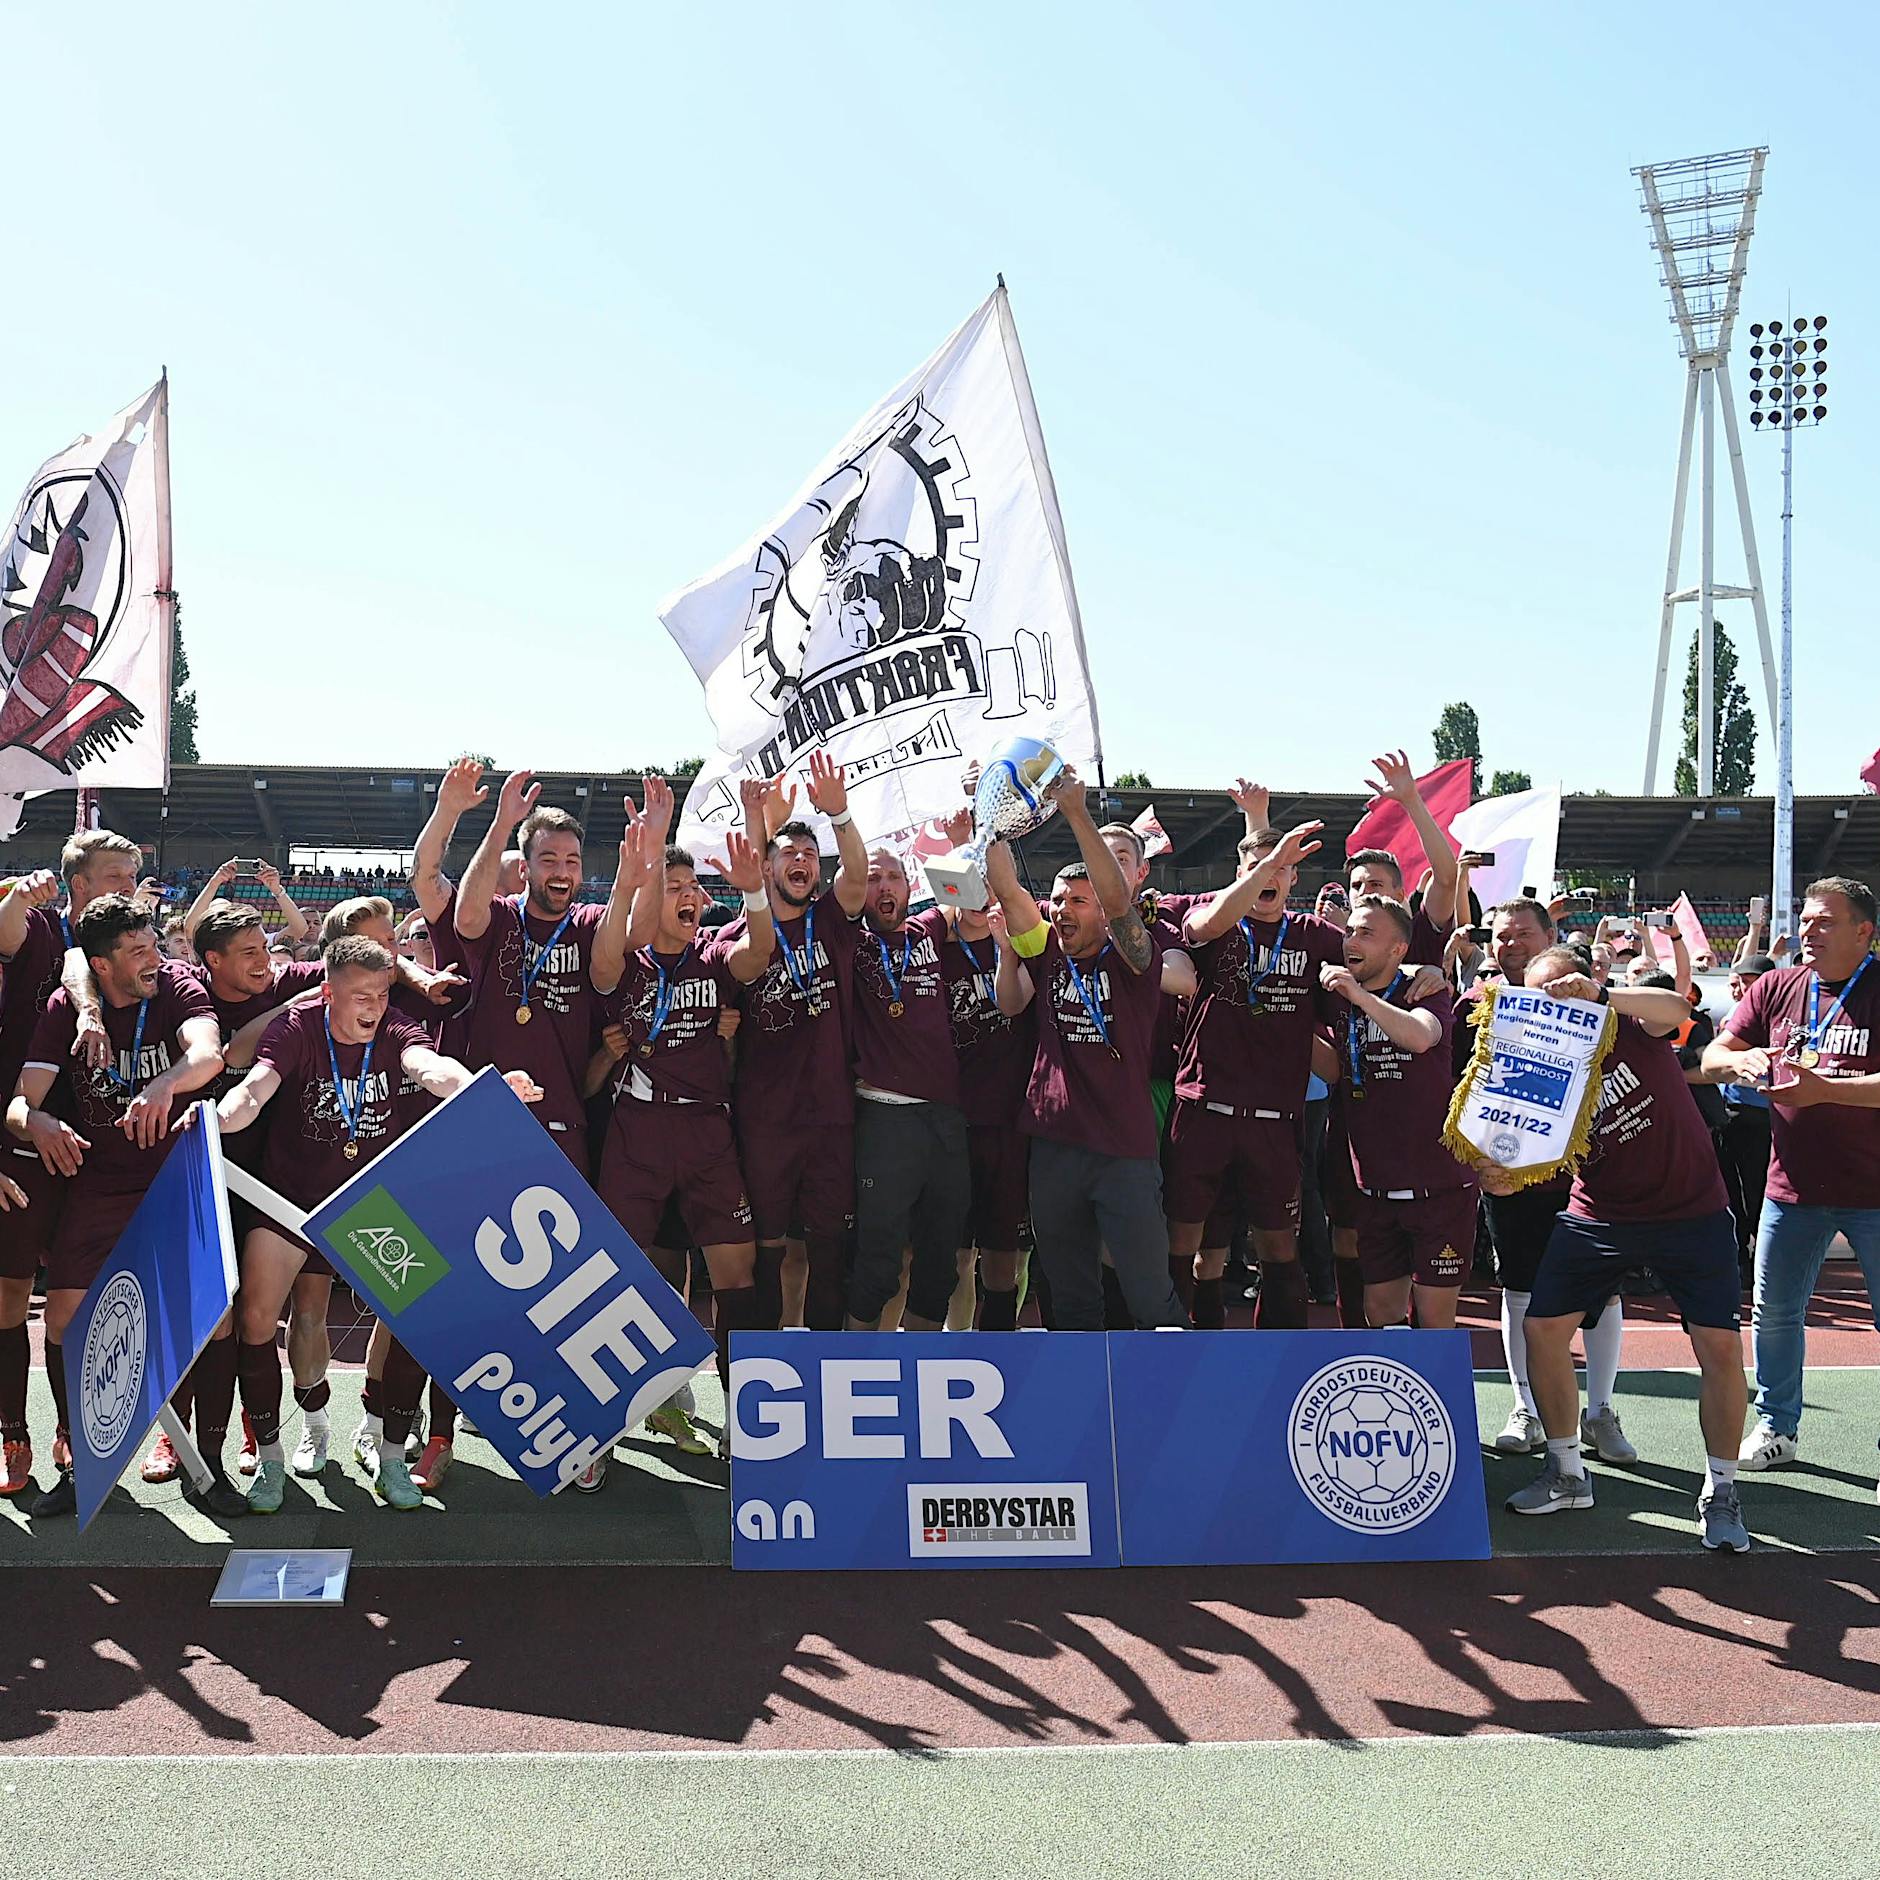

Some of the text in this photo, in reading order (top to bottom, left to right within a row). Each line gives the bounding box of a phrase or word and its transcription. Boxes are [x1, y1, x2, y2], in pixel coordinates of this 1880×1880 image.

[1497, 1013, 1593, 1042] Regionalliga Nordost
[1498, 996, 1599, 1030] MEISTER
[1523, 1029, 1559, 1045] Herren
[1496, 1041, 1574, 1069] REGIONALLIGA
[1516, 1062, 1569, 1083] NORDOST
[1478, 1106, 1553, 1137] 2021/22
[861, 1178, 874, 1188] 79
[347, 1231, 358, 1243] Die
[356, 1226, 425, 1285] AOK
[1438, 1267, 1459, 1275] JAKO
[84, 1282, 139, 1392] NORDOSTDEUTSCHER
[94, 1326, 130, 1399] NOFV
[90, 1349, 142, 1446] FUSSBALLVERBAND
[729, 1357, 1016, 1461] GER
[1300, 1367, 1441, 1432] NORDOSTDEUTSCHER
[1329, 1430, 1414, 1458] NOFV
[1309, 1470, 1441, 1522] FUSSBALLVERBAND
[731, 1499, 816, 1541] an
[922, 1497, 1076, 1528] DERBYSTAR
[953, 1529, 1072, 1541] THE BALL
